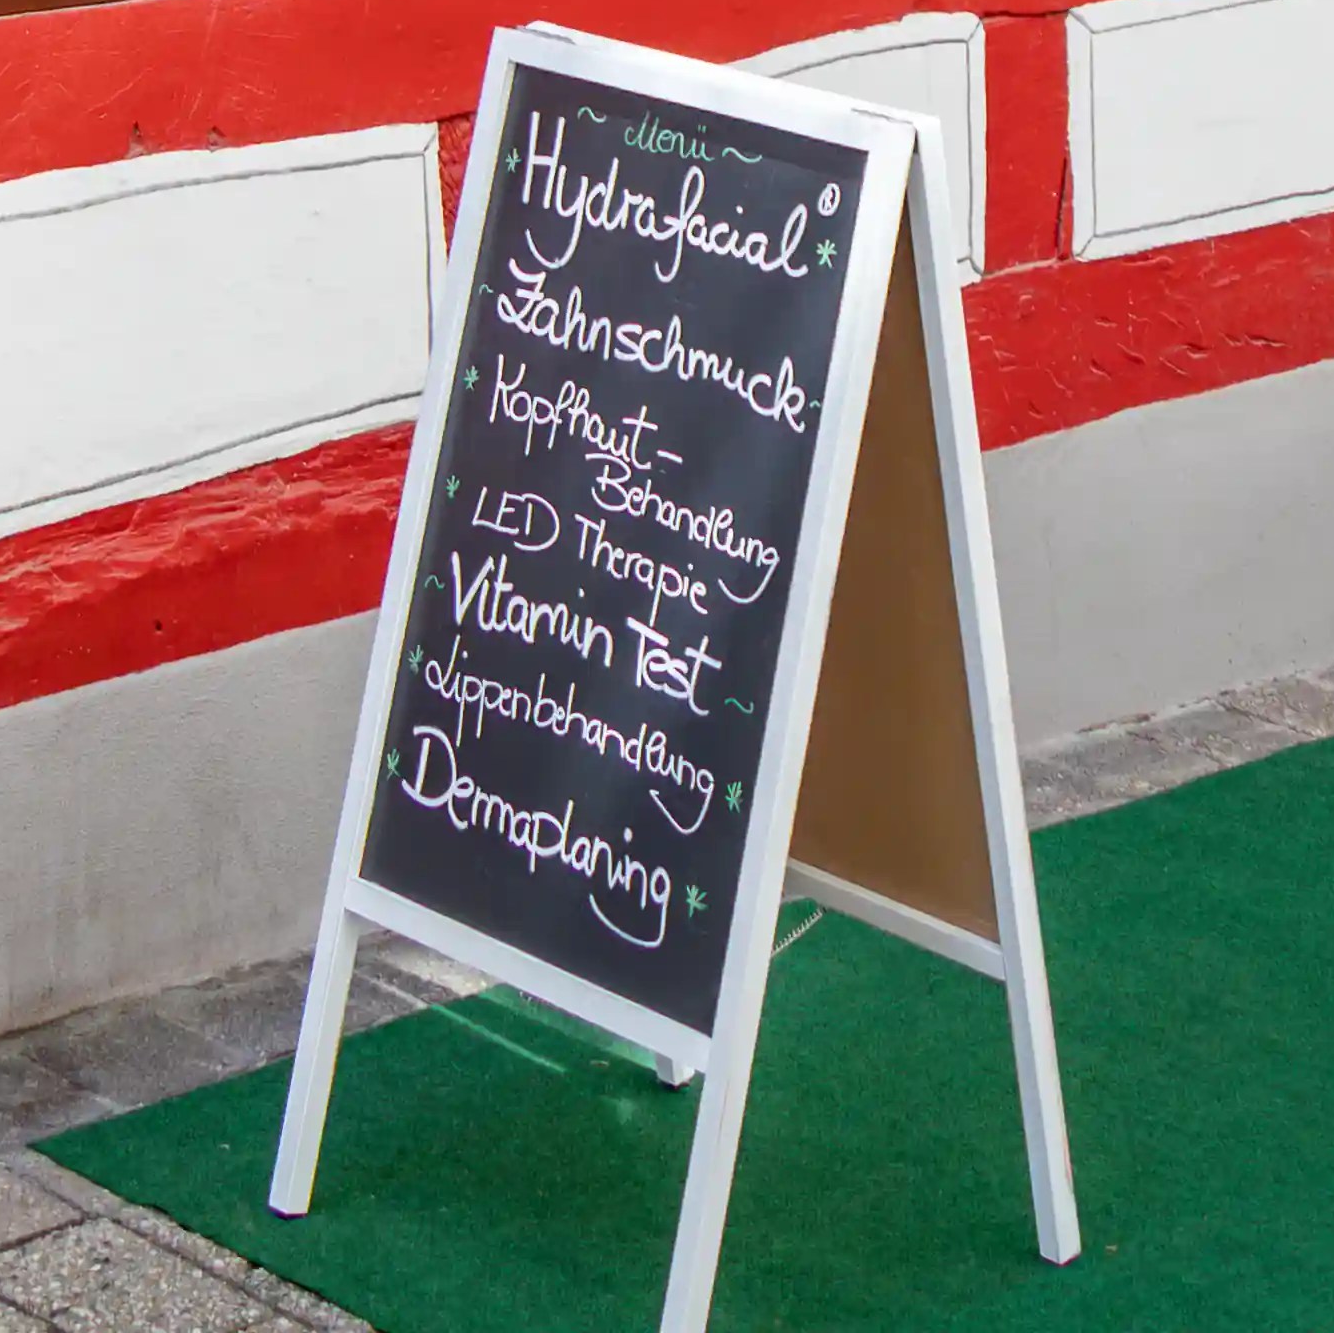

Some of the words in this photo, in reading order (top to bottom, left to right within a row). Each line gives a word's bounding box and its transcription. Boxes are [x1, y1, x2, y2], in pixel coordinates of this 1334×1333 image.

[623, 109, 716, 162] Menü
[496, 257, 807, 434] Zahnschmuck
[471, 485, 561, 552] LED
[573, 512, 709, 627] Therapie
[584, 453, 781, 605] Behandlung
[450, 550, 614, 668] Vitamin
[625, 616, 723, 716] Test
[424, 634, 716, 835] Lippenbehandlung
[401, 725, 671, 949] Dermaplaning
